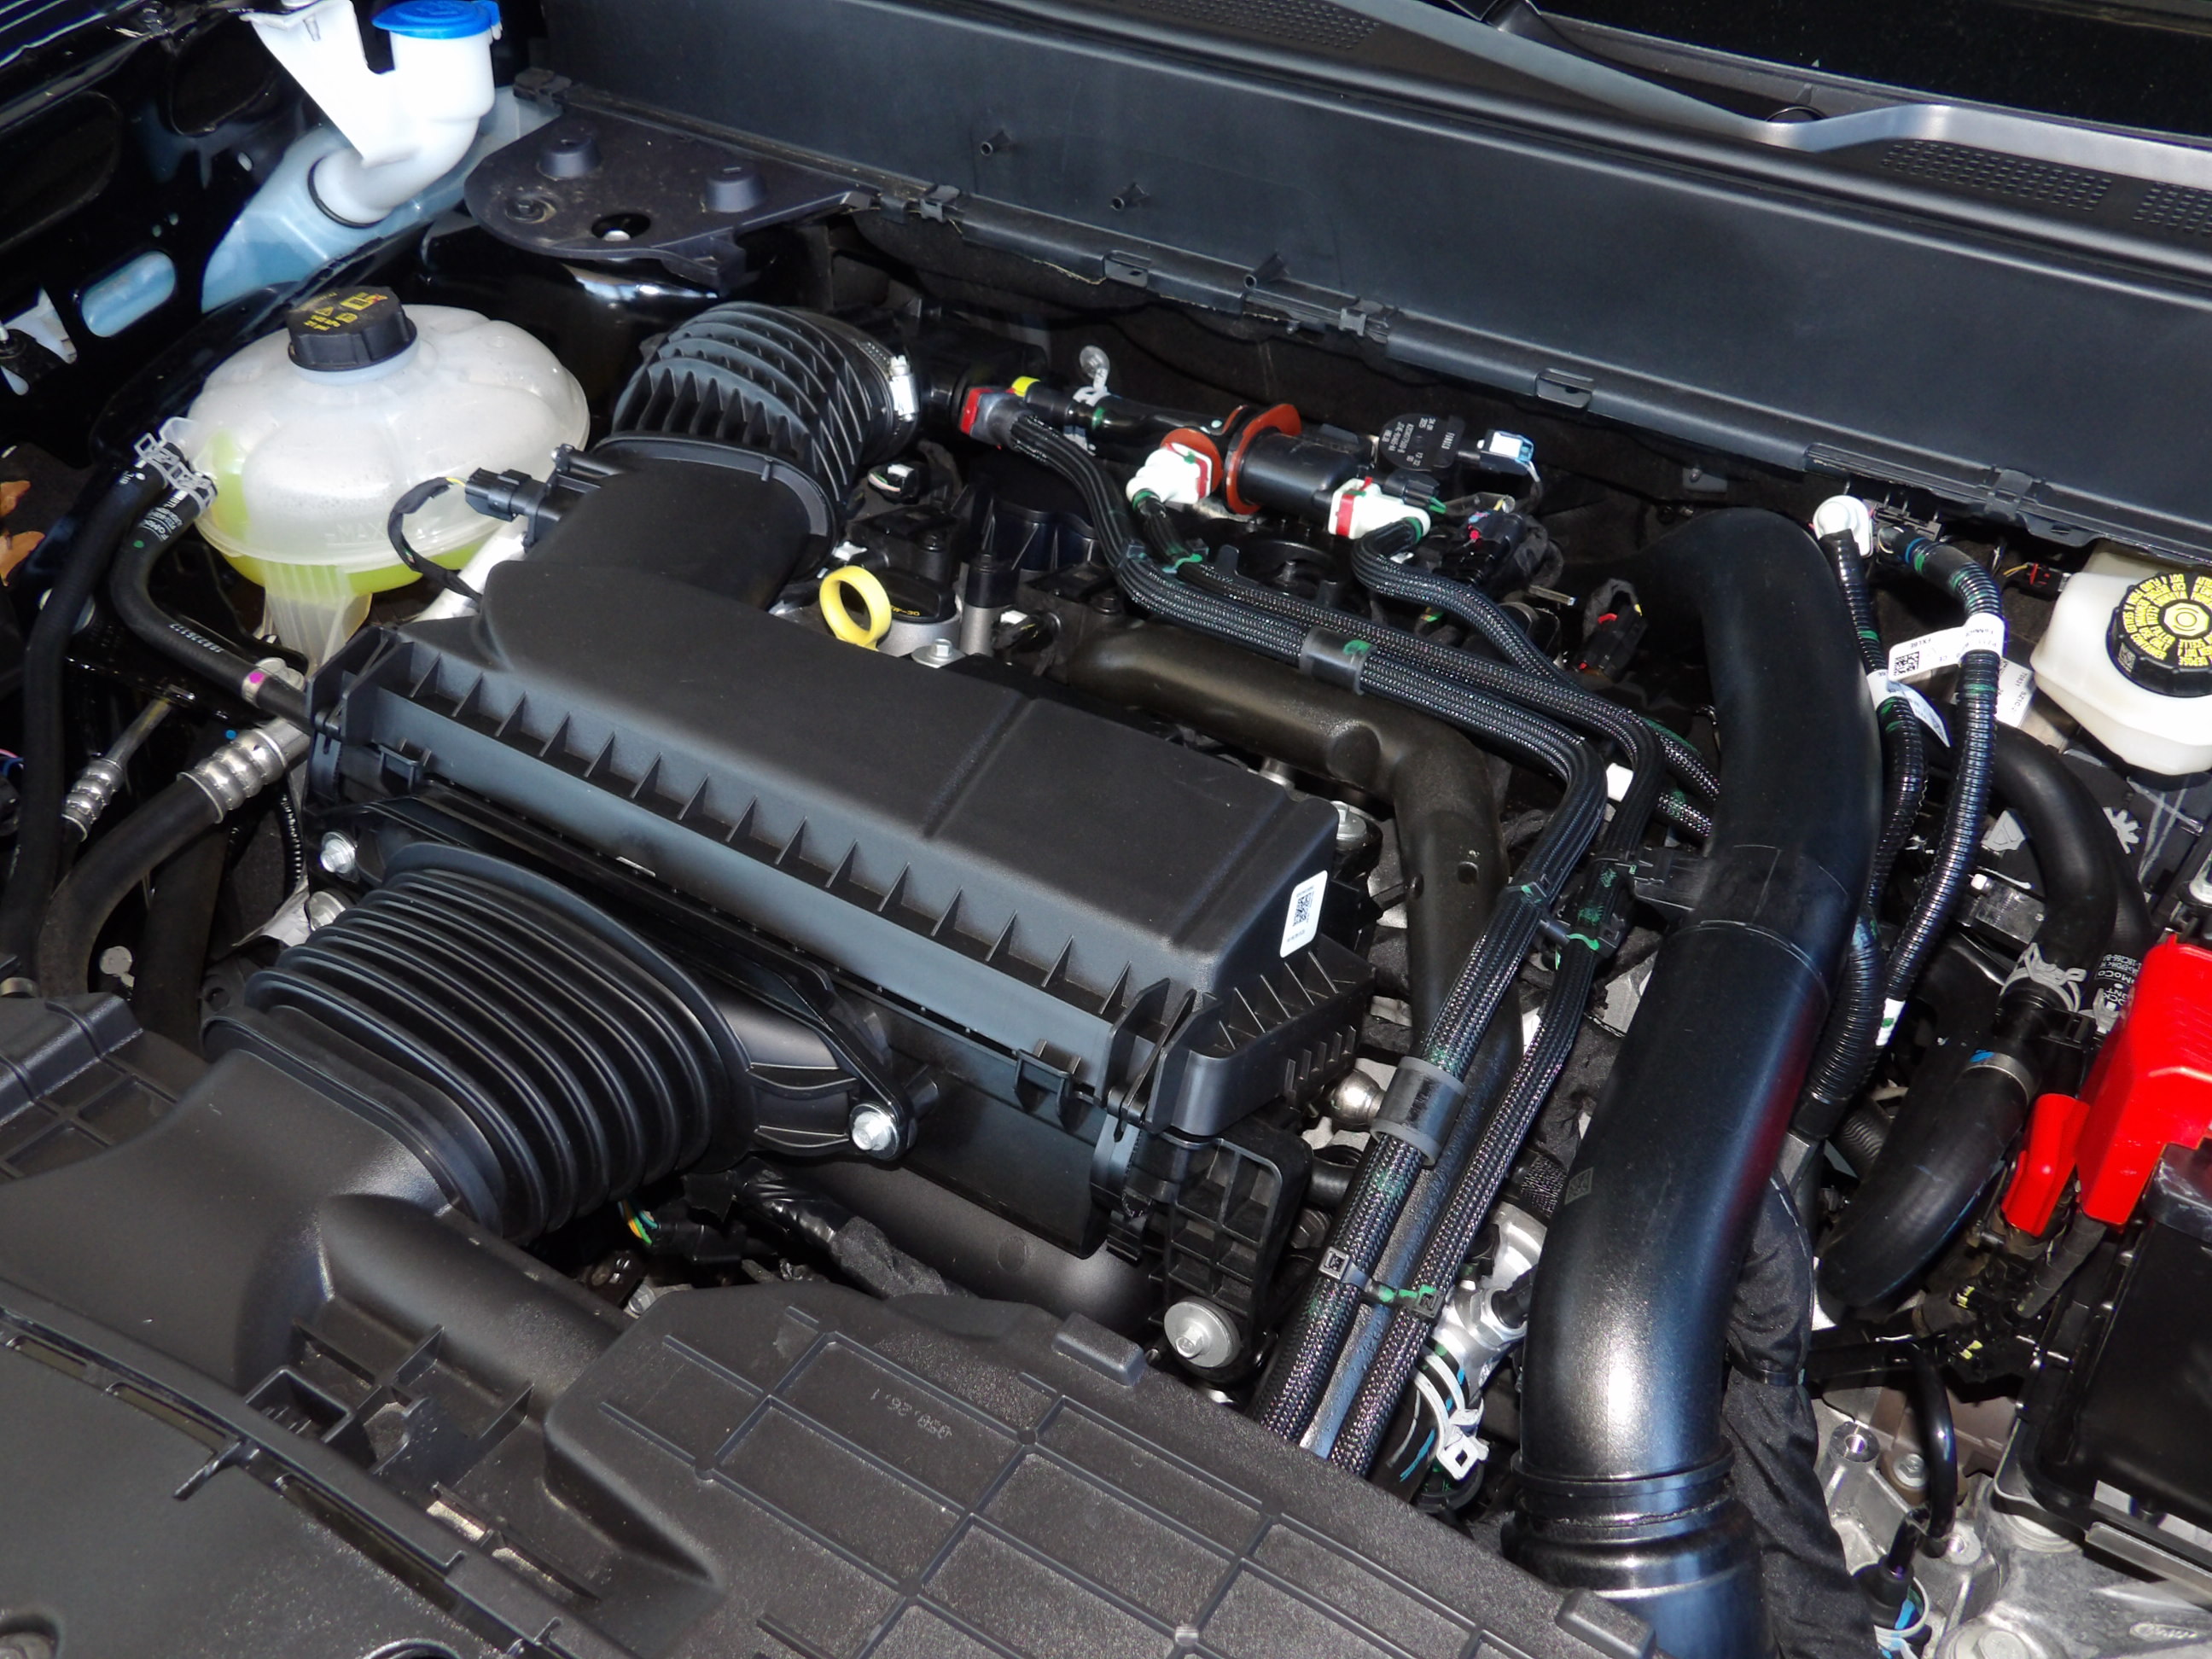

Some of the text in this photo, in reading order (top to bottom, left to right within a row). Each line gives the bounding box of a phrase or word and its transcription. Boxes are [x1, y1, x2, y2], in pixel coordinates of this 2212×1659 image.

[2171, 582, 2186, 592] CAP
[889, 604, 921, 616] W-30
[2145, 604, 2160, 626] CLEAN
[2122, 610, 2139, 633] SEALED
[2130, 632, 2168, 661] CONTAINER
